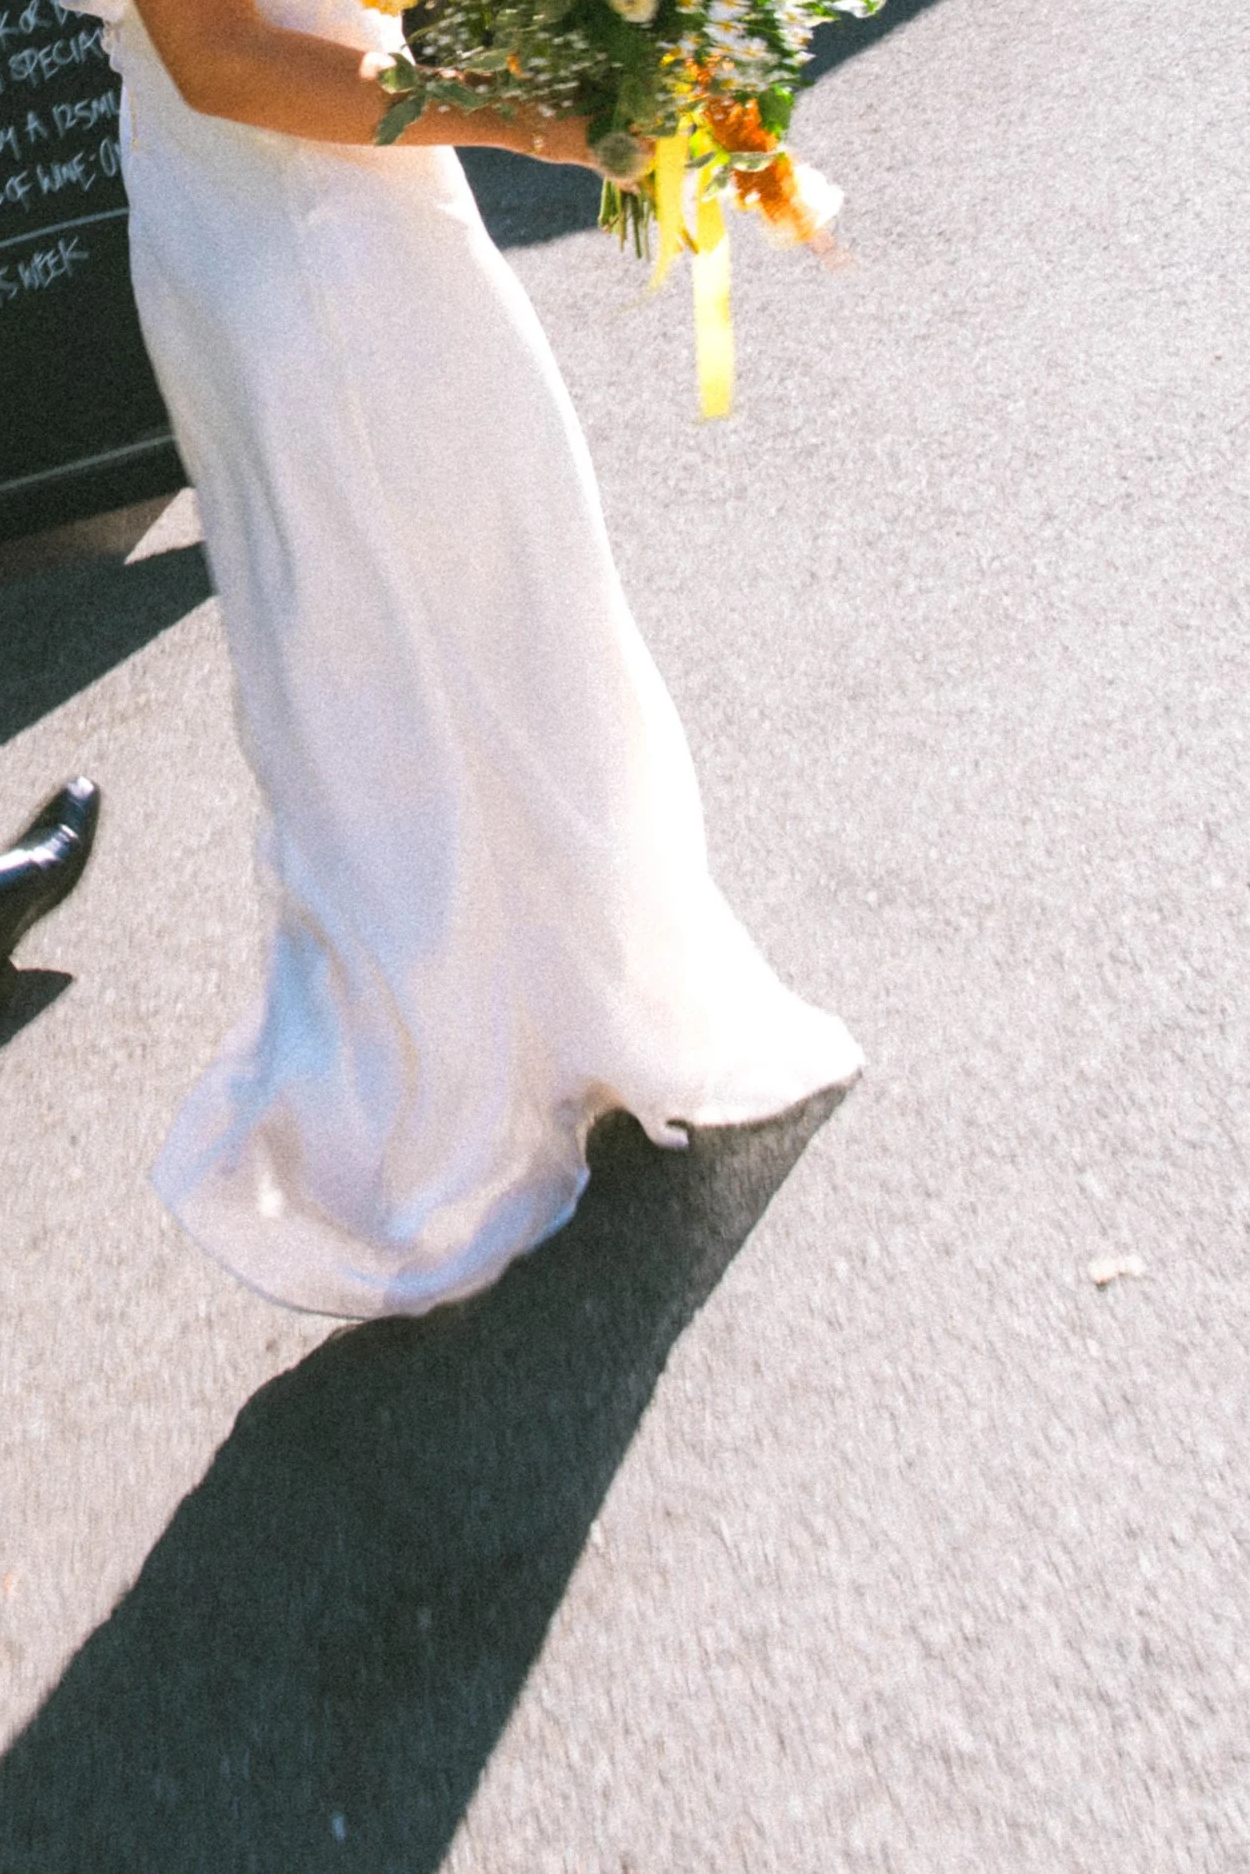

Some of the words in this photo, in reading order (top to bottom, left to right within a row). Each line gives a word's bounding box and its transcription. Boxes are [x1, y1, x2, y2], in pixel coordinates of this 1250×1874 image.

[9, 26, 103, 86] SPECIA
[25, 111, 48, 142] A
[4, 169, 33, 211] OF
[18, 236, 90, 290] WEEK
